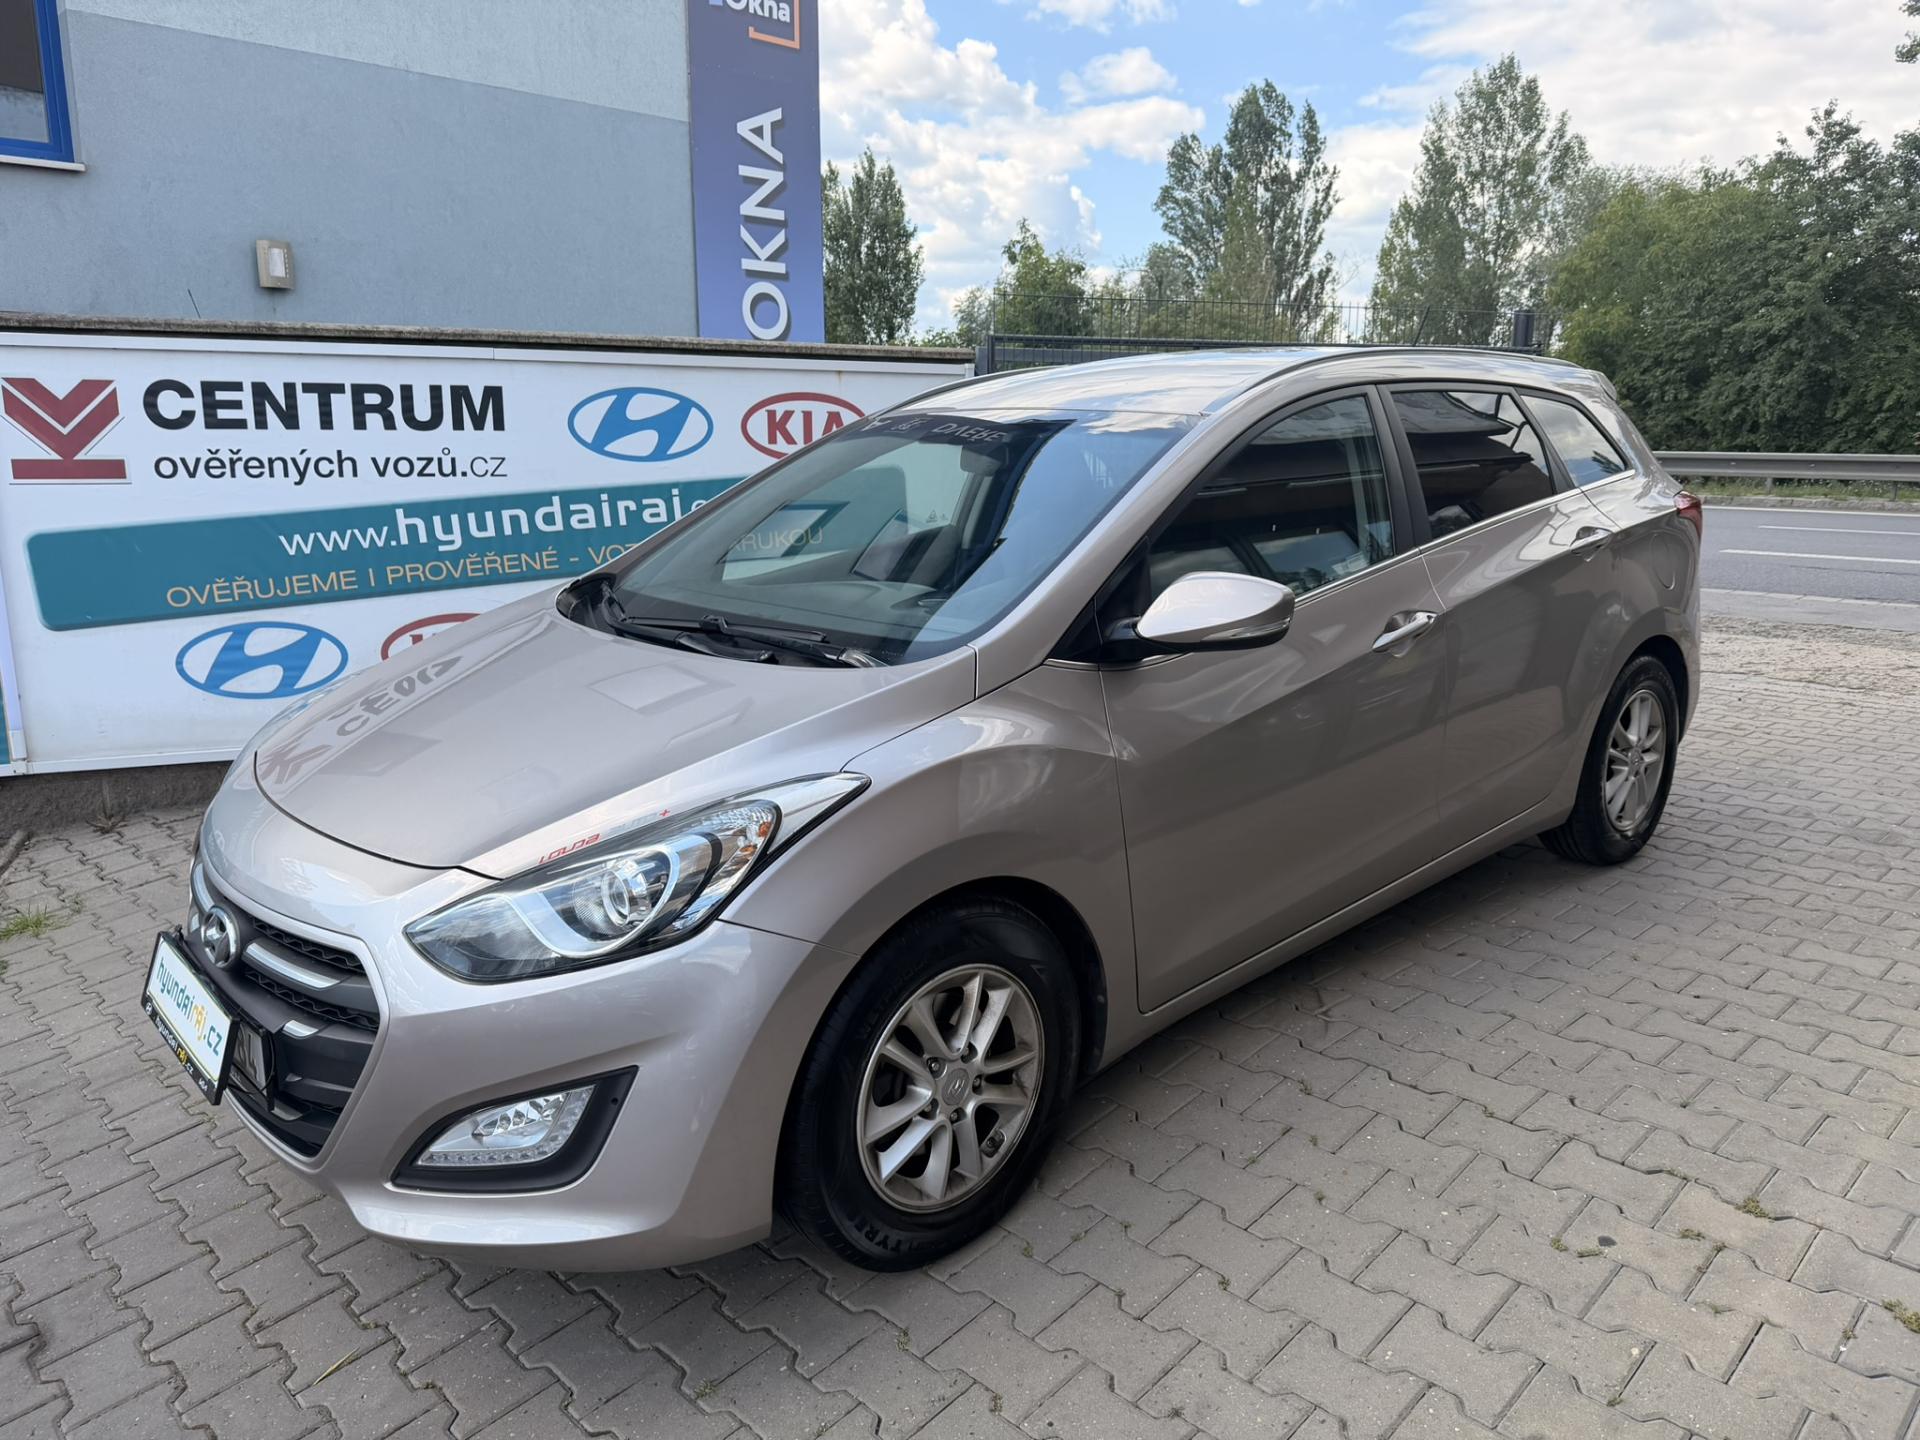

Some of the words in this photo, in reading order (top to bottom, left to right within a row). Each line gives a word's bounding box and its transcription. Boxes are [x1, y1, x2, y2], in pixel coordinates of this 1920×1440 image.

[737, 107, 788, 341] OKNA
[143, 379, 505, 431] CENTRUM
[765, 409, 844, 445] KIA
[154, 448, 358, 486] ověřených
[166, 570, 358, 608] OVĚŘUJEME
[368, 568, 375, 587] I
[386, 546, 560, 585] PROVĚŘENÉ
